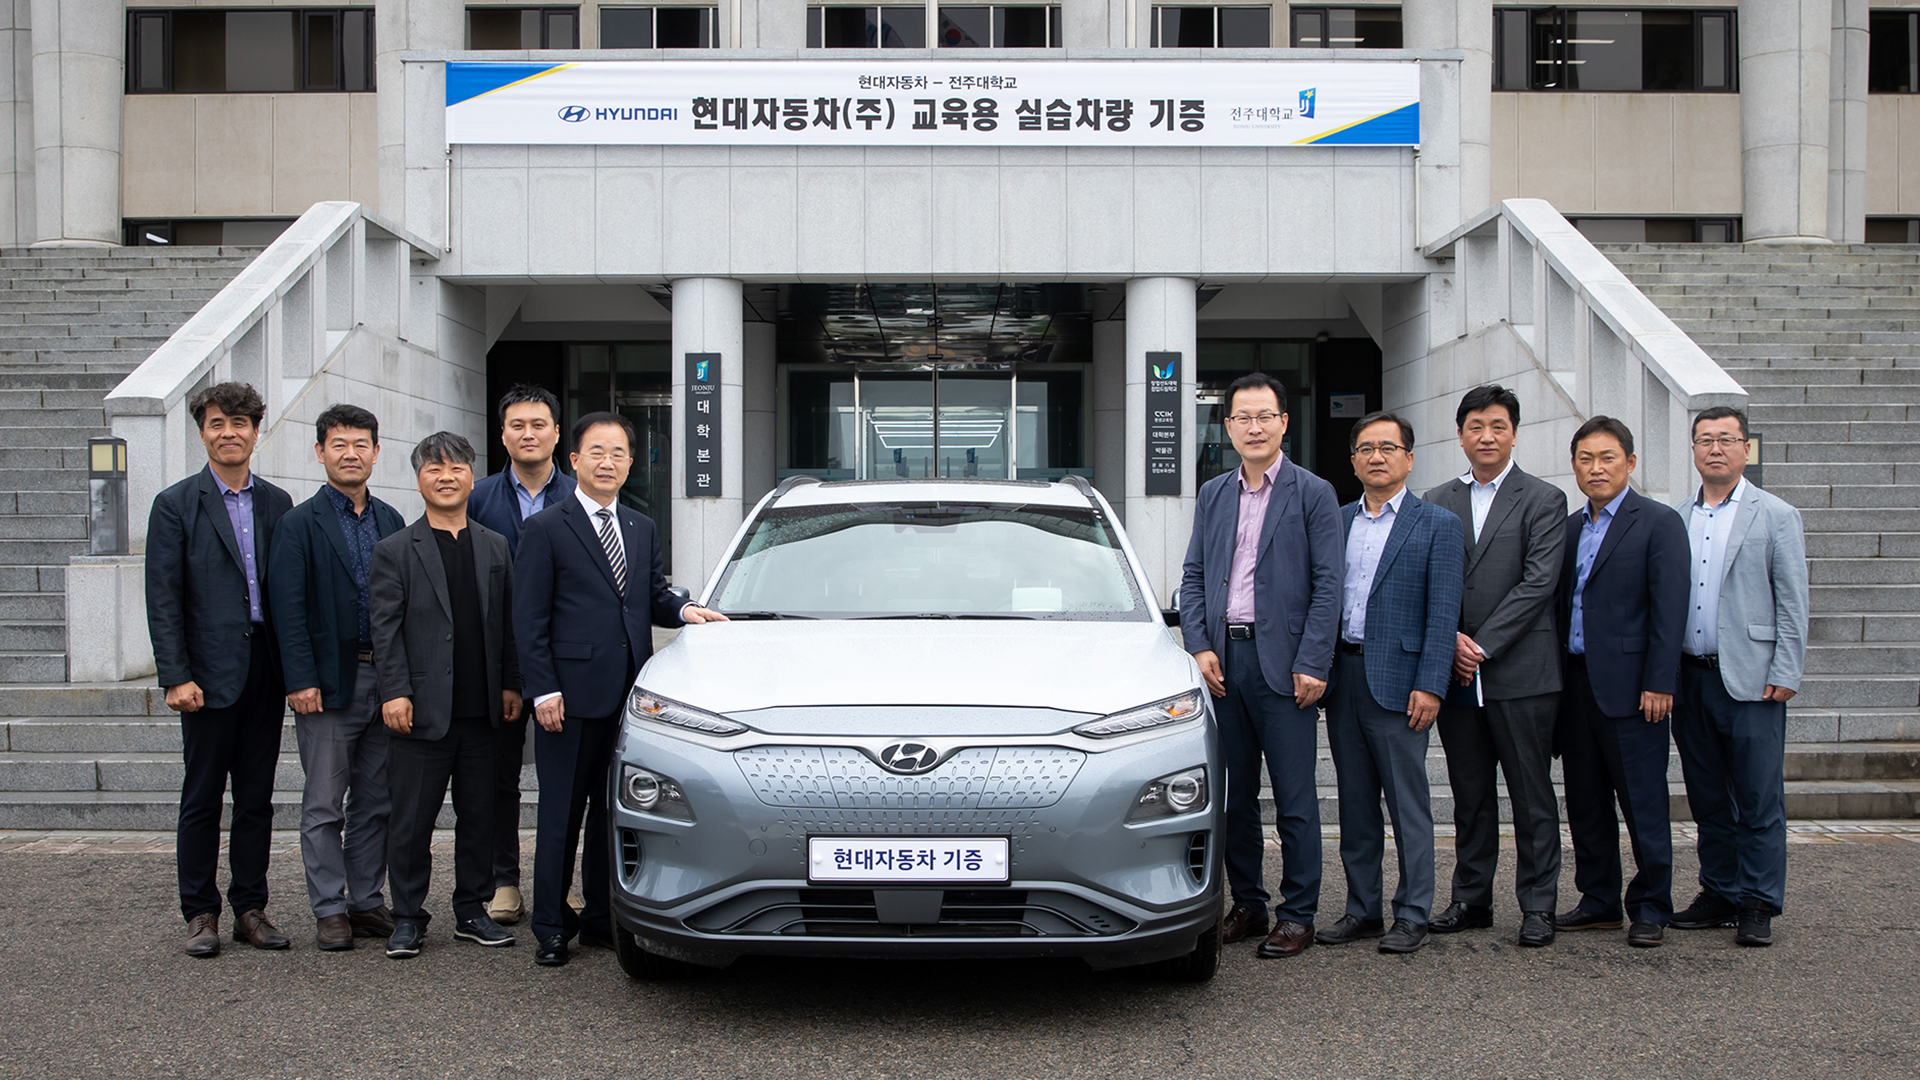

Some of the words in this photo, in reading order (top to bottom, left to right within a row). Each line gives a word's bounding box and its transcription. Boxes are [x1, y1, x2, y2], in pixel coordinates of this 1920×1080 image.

[858, 75, 928, 91] 현대자동차
[948, 75, 1018, 91] 전주대학교
[596, 108, 677, 121] HYUNDAI
[692, 97, 895, 132] 현대자동차(주)
[912, 97, 999, 132] 교육용
[1015, 97, 1134, 133] 실습차량
[1149, 98, 1206, 133] 기증
[1230, 106, 1294, 122] 전주대학교
[834, 848, 936, 871] 현대자동차
[944, 848, 983, 871] 기증
